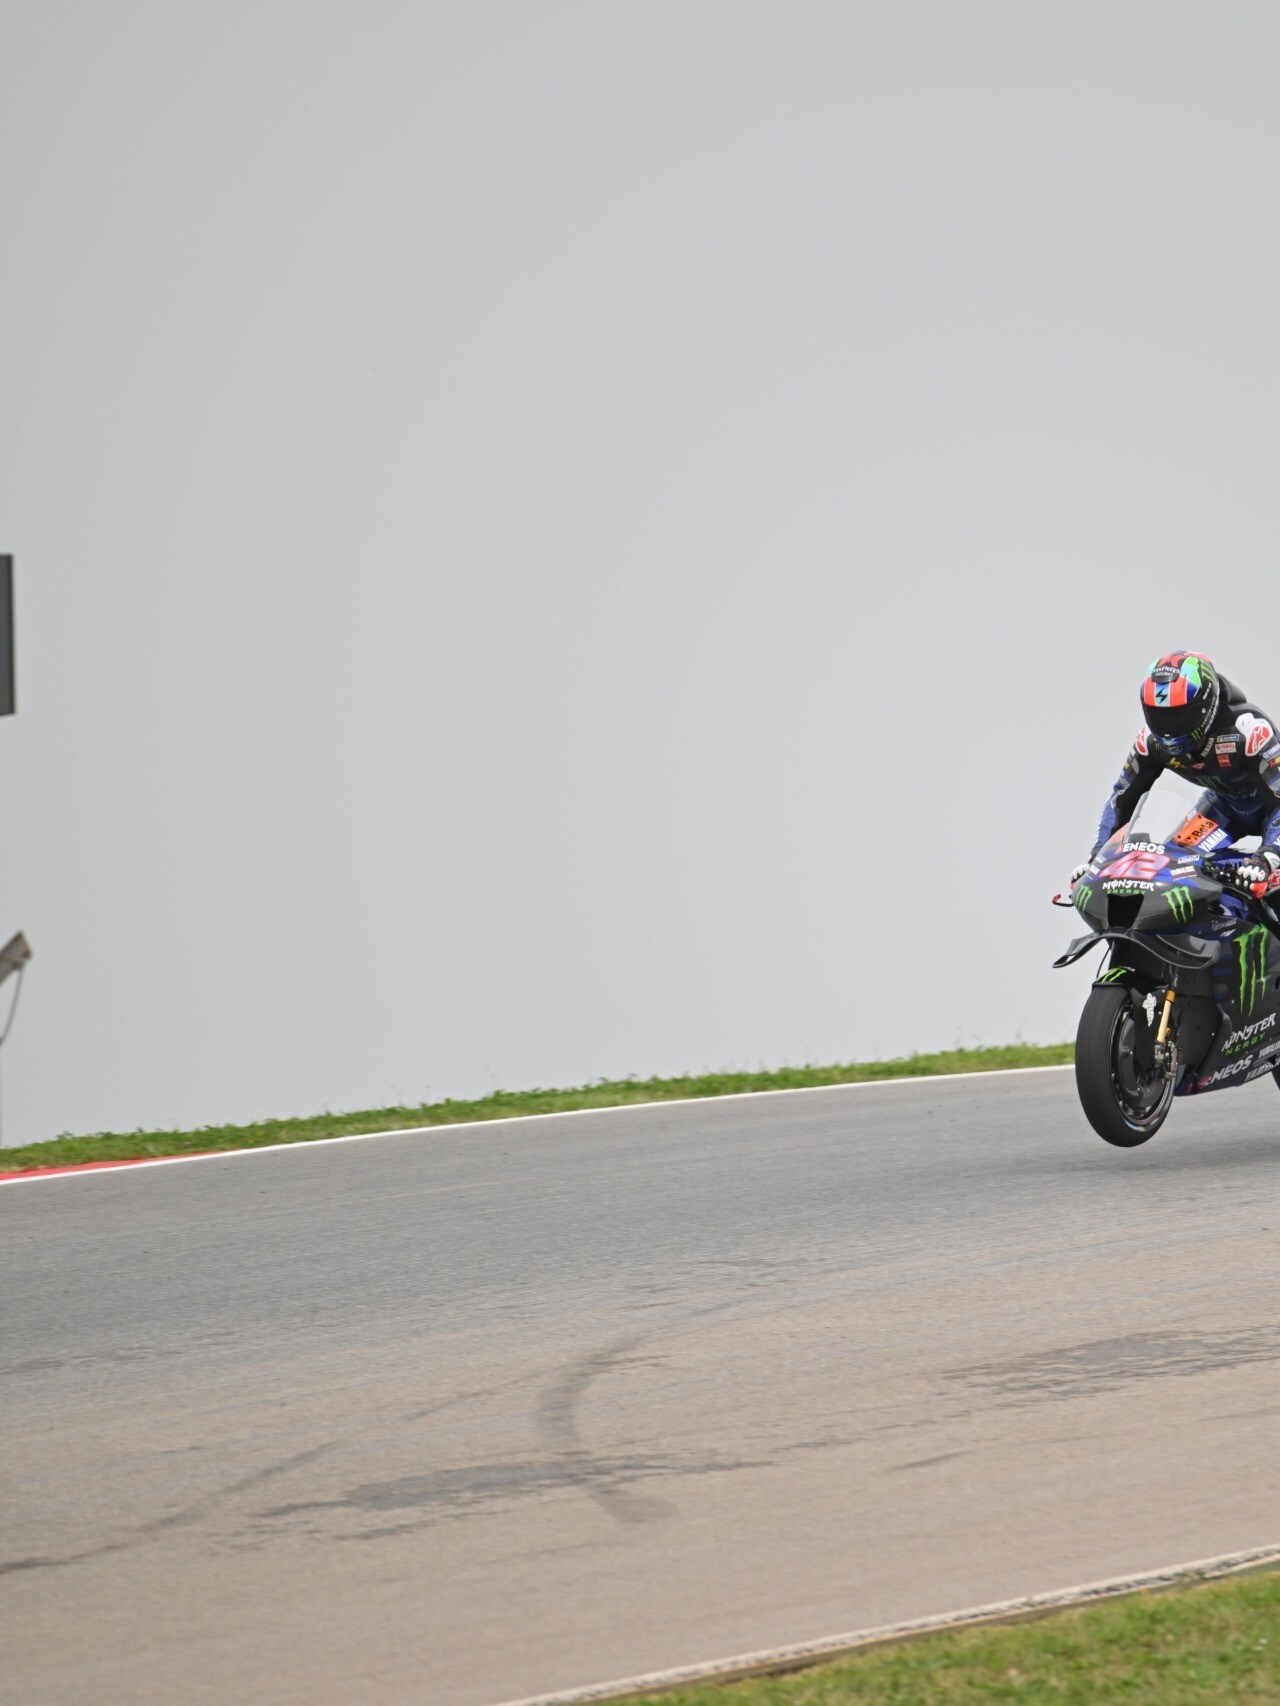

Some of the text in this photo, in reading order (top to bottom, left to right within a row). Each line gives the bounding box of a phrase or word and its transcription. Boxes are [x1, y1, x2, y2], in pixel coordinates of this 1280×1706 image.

[1123, 842, 1165, 854] ENEOS
[1198, 828, 1228, 852] YAMAHA
[1099, 850, 1171, 880] 42
[1103, 879, 1154, 892] MONSTER
[1225, 1032, 1265, 1056] NERGY
